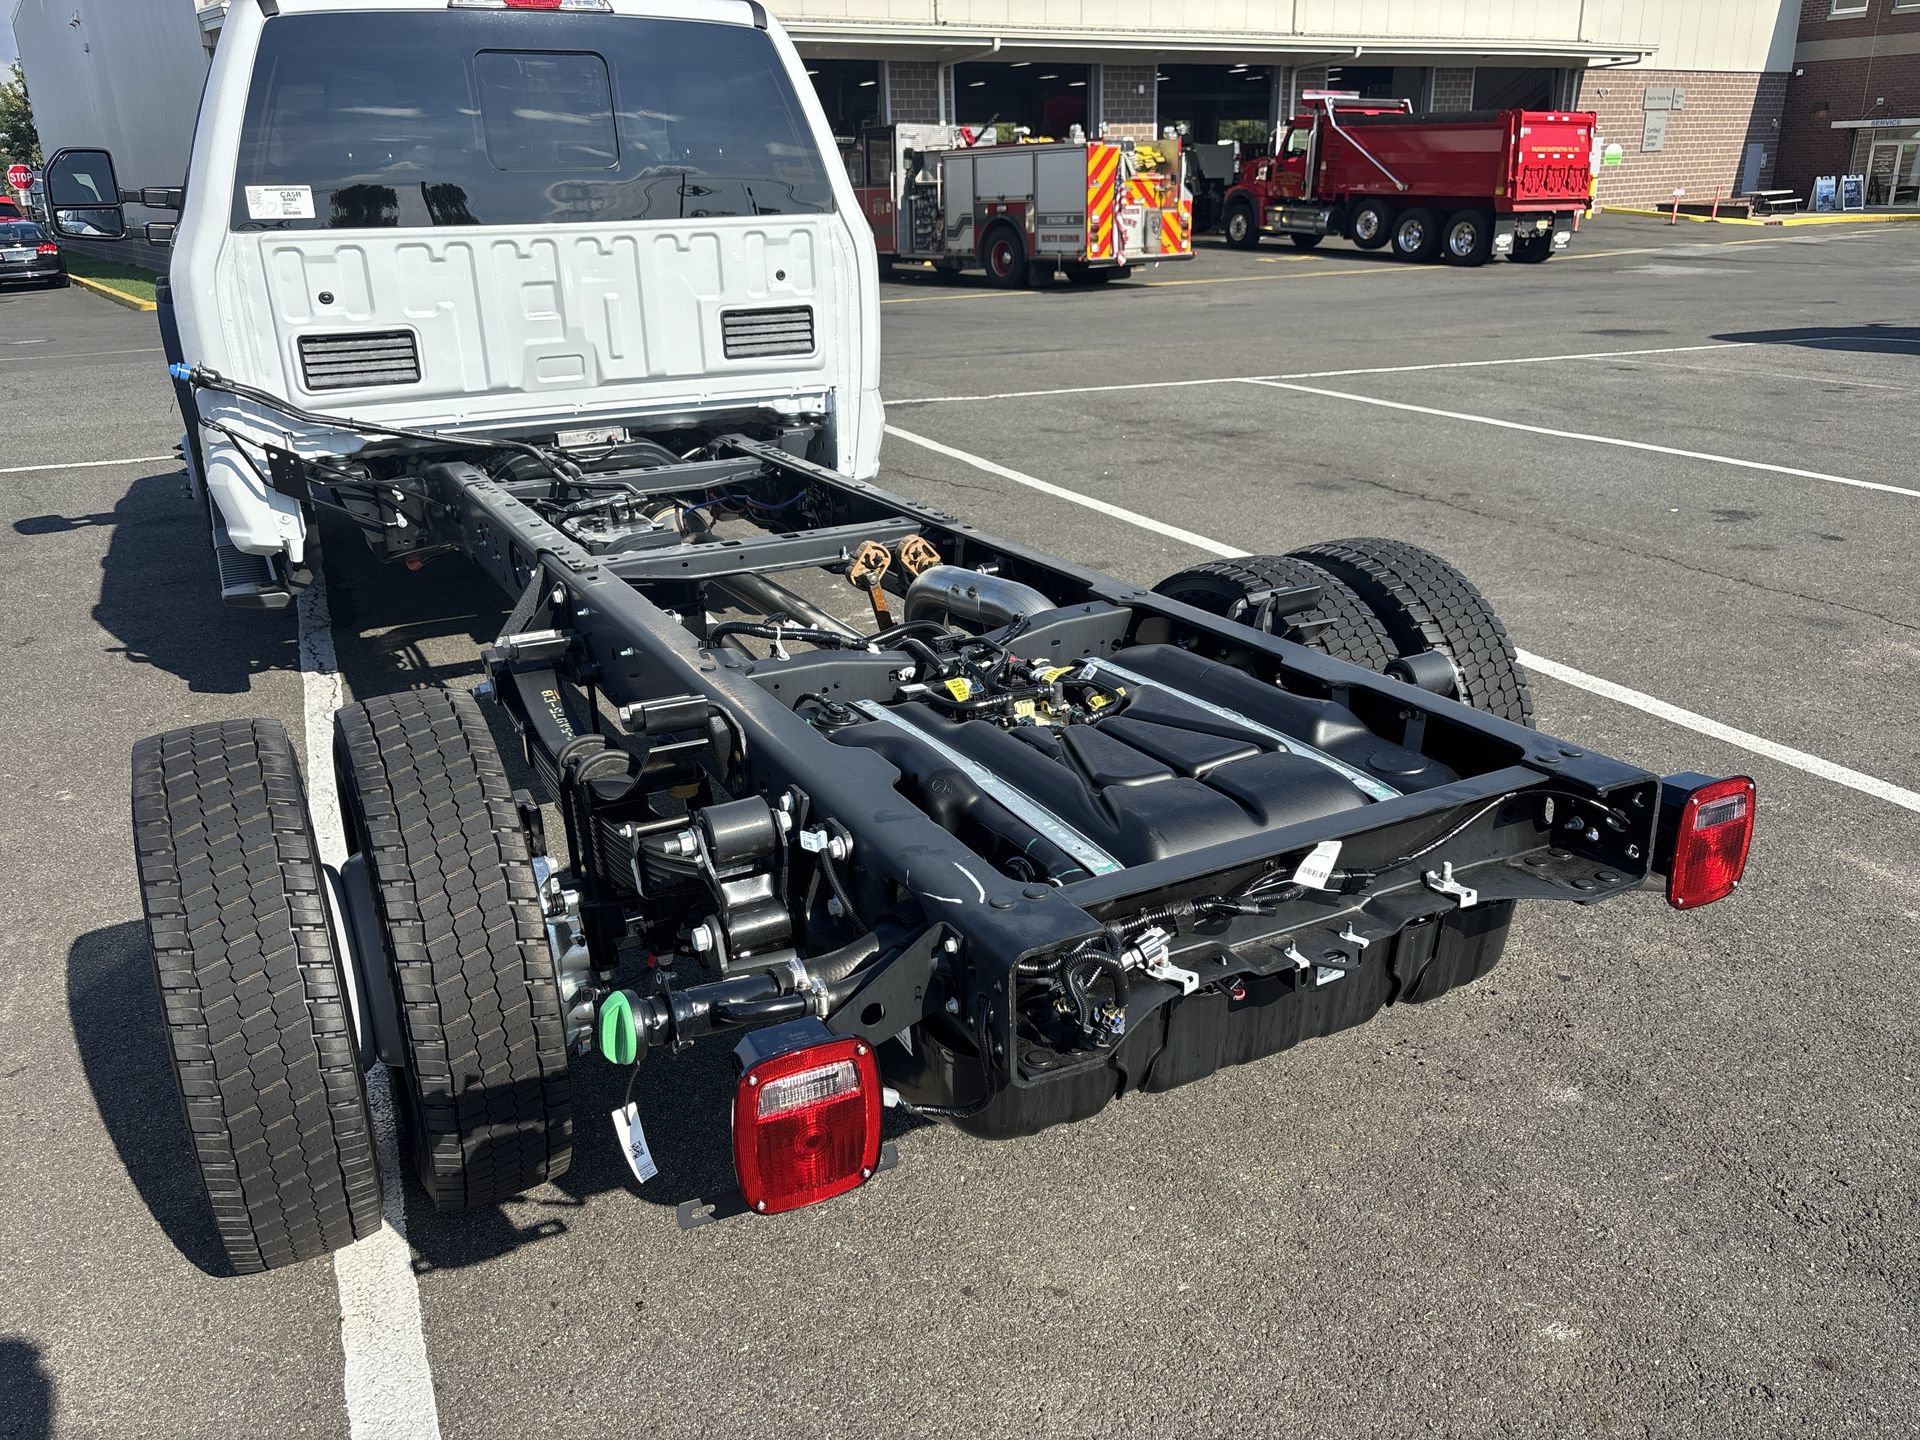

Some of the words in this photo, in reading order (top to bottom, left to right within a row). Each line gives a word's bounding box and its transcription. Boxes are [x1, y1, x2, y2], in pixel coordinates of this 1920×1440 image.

[9, 172, 32, 183] STOP
[1046, 216, 1067, 224] ENGINE
[1069, 216, 1075, 224] 4
